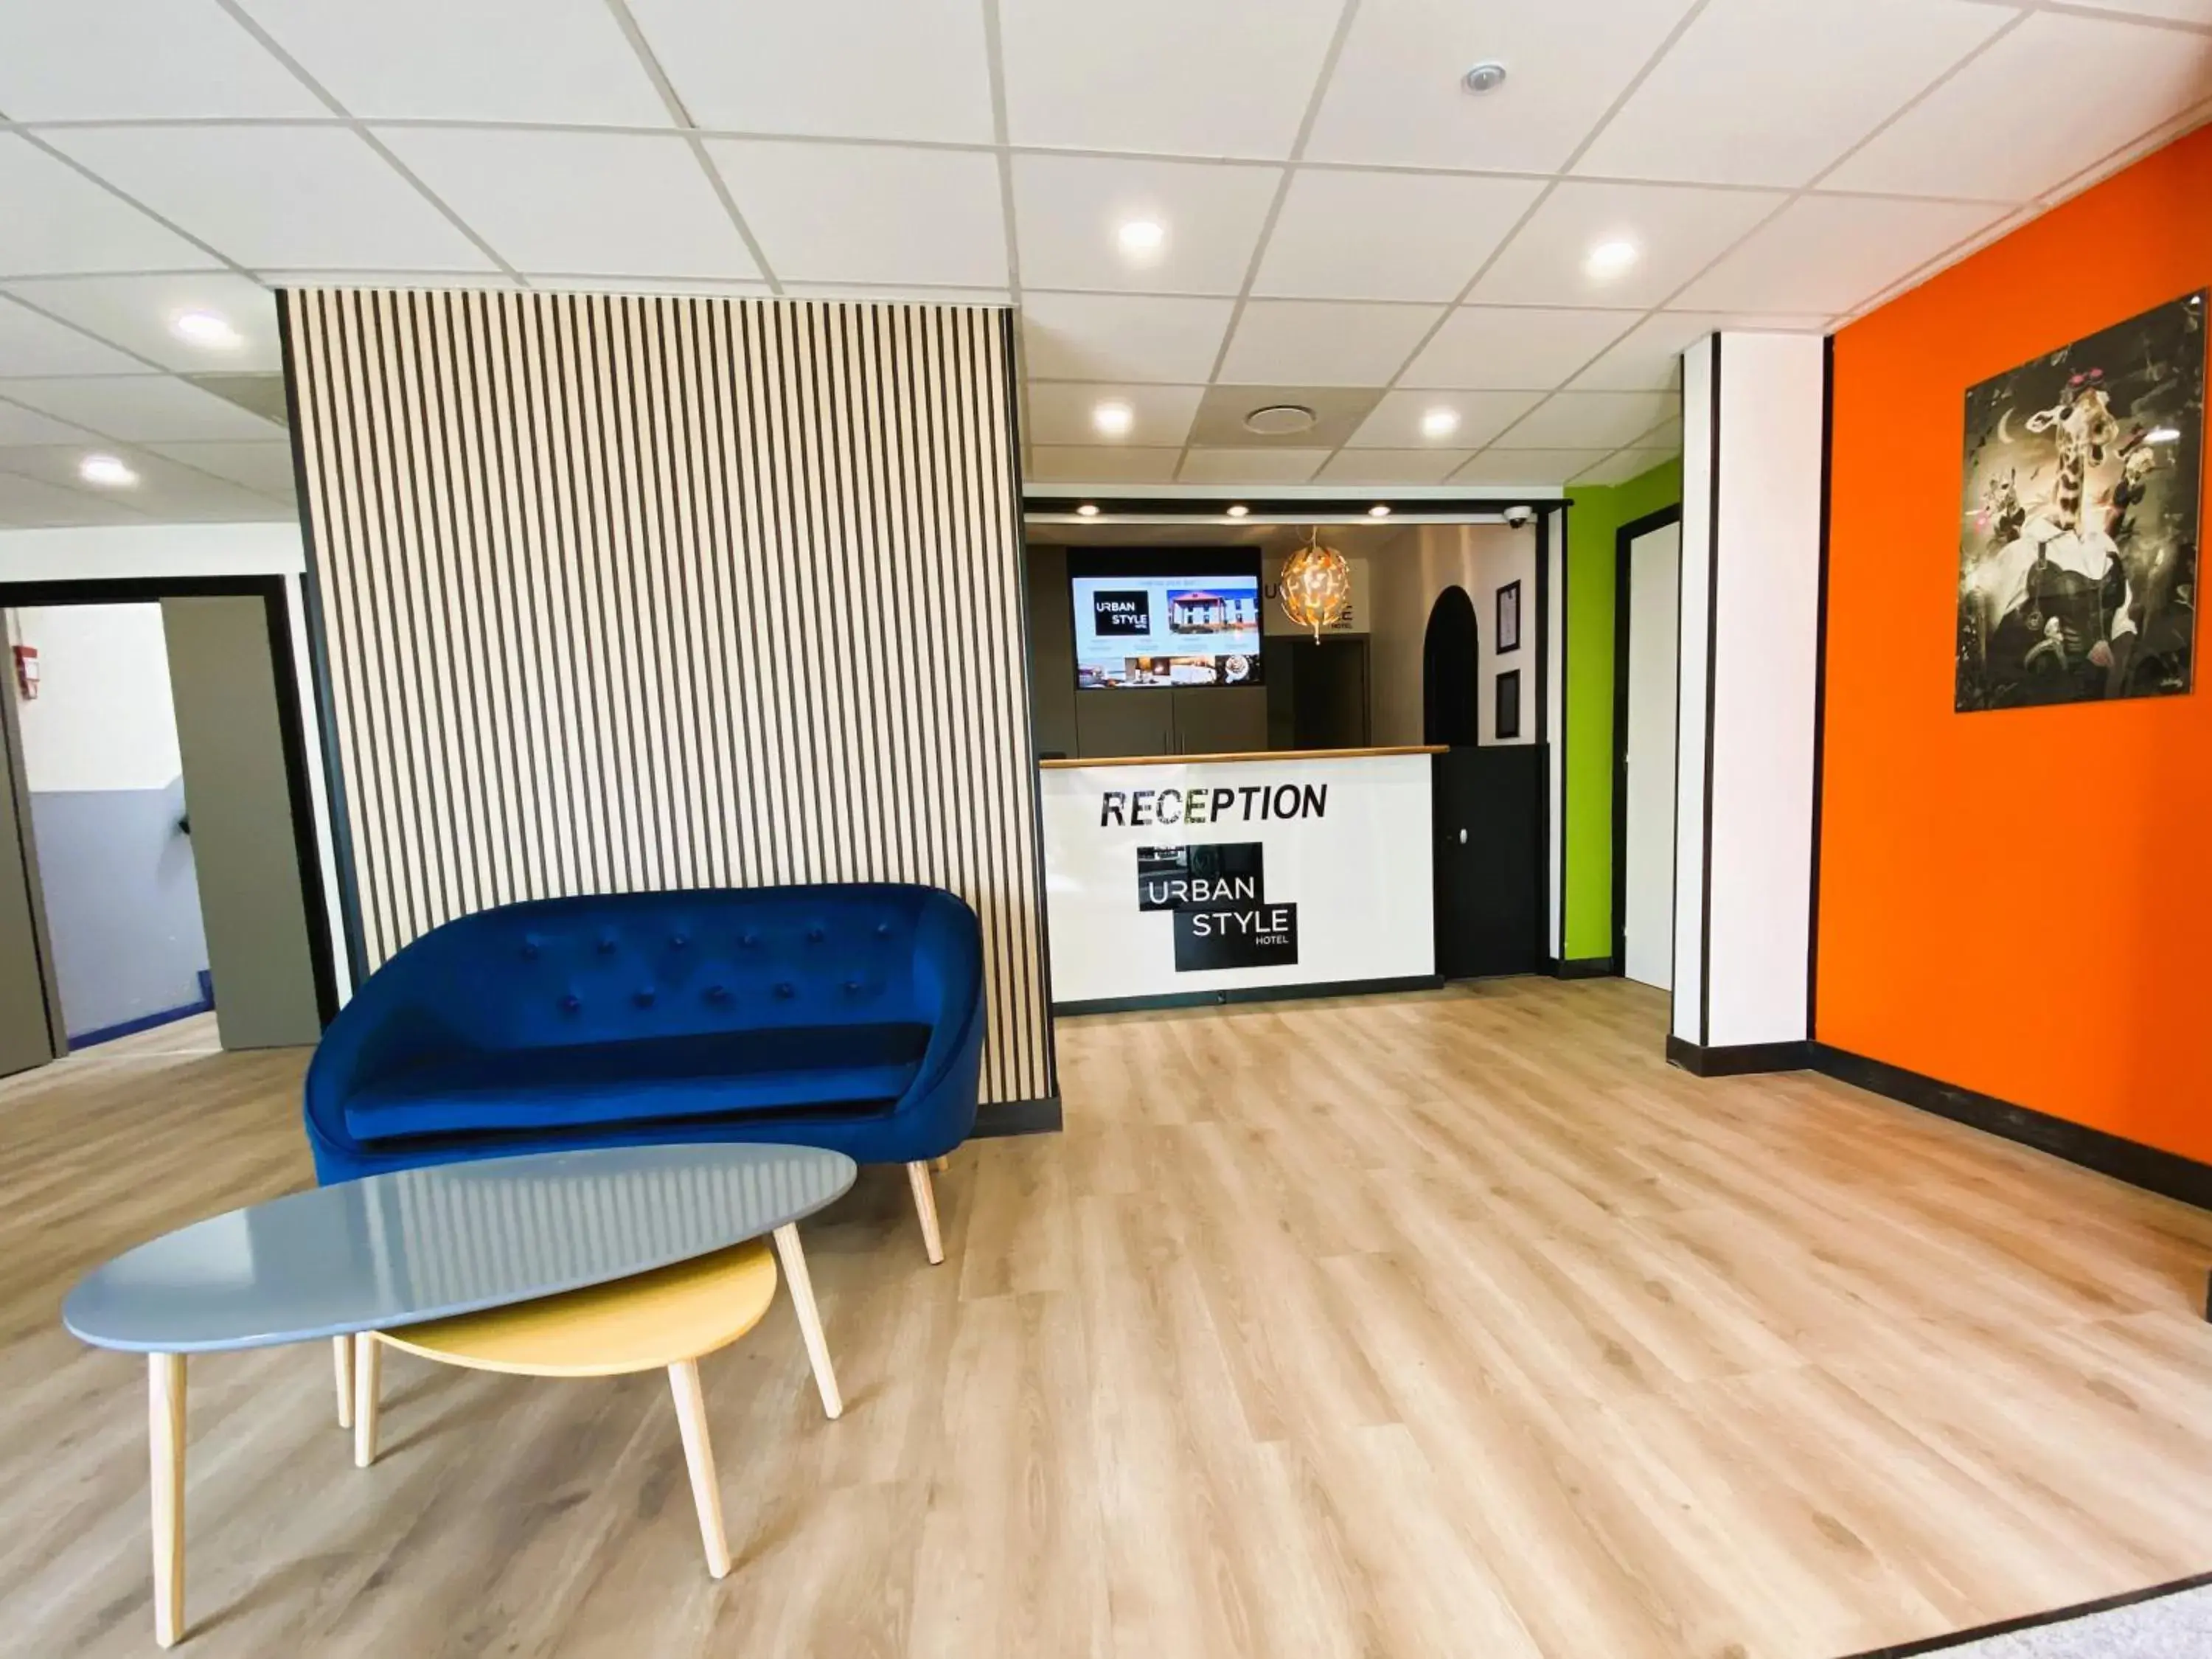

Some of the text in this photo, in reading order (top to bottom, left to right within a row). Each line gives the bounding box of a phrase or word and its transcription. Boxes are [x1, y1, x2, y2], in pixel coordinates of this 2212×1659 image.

[1096, 601, 1135, 612] URBAN
[1112, 613, 1147, 625] STYLE
[1101, 784, 1327, 827] RECEPTION
[1149, 877, 1254, 904] URBAN
[1192, 909, 1289, 936] STYLE
[1256, 936, 1289, 945] HOTEL
